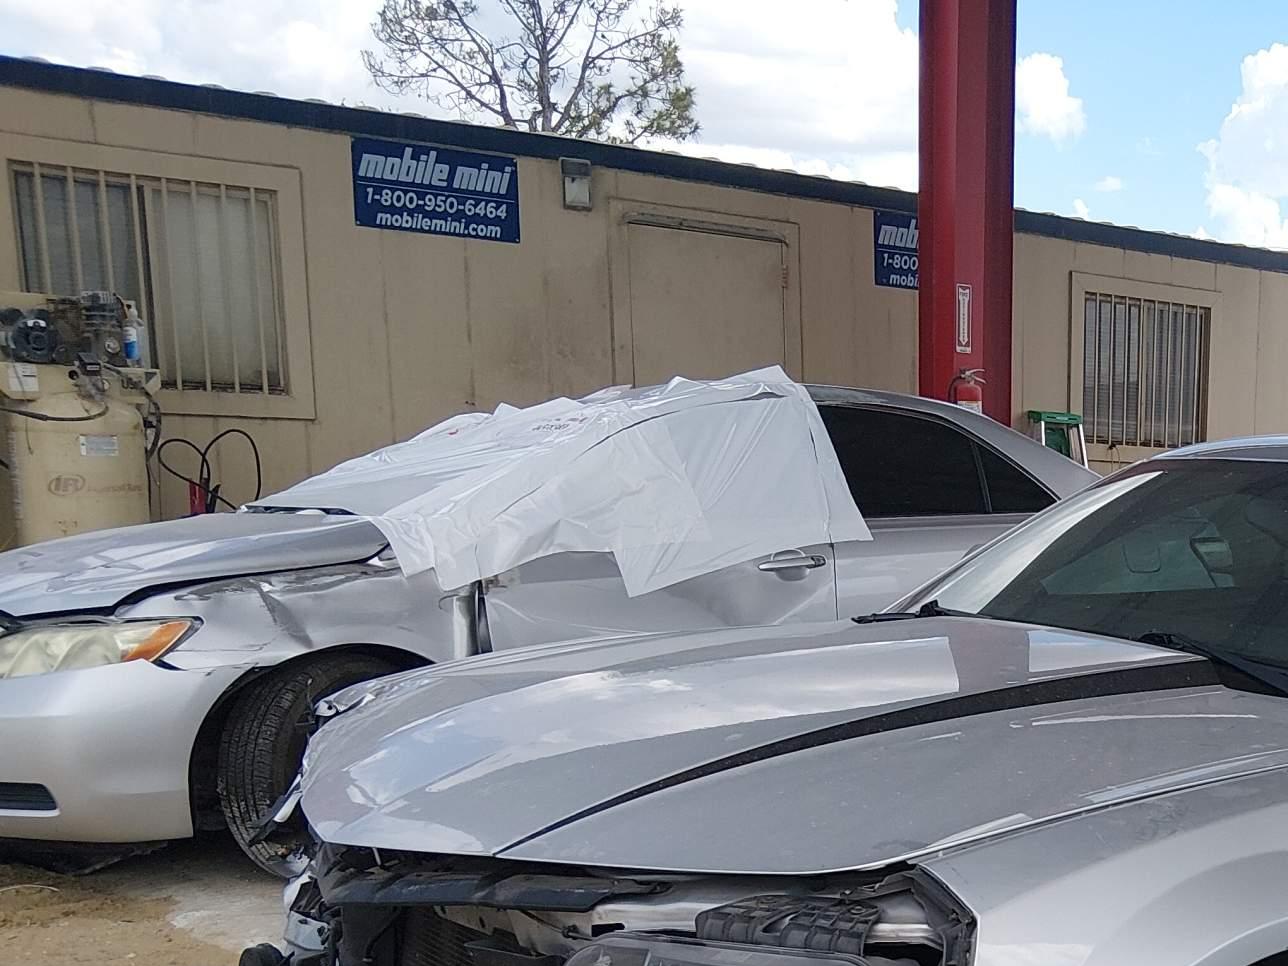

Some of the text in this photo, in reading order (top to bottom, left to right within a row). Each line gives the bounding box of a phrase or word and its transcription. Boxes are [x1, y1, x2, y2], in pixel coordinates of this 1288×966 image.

[358, 147, 512, 195] mobile mini
[366, 187, 507, 220] 1-800-950-6464
[375, 212, 501, 238] mobilemini.com
[877, 219, 920, 249] mob
[883, 253, 919, 270] 1-800
[889, 273, 920, 288] mobi
